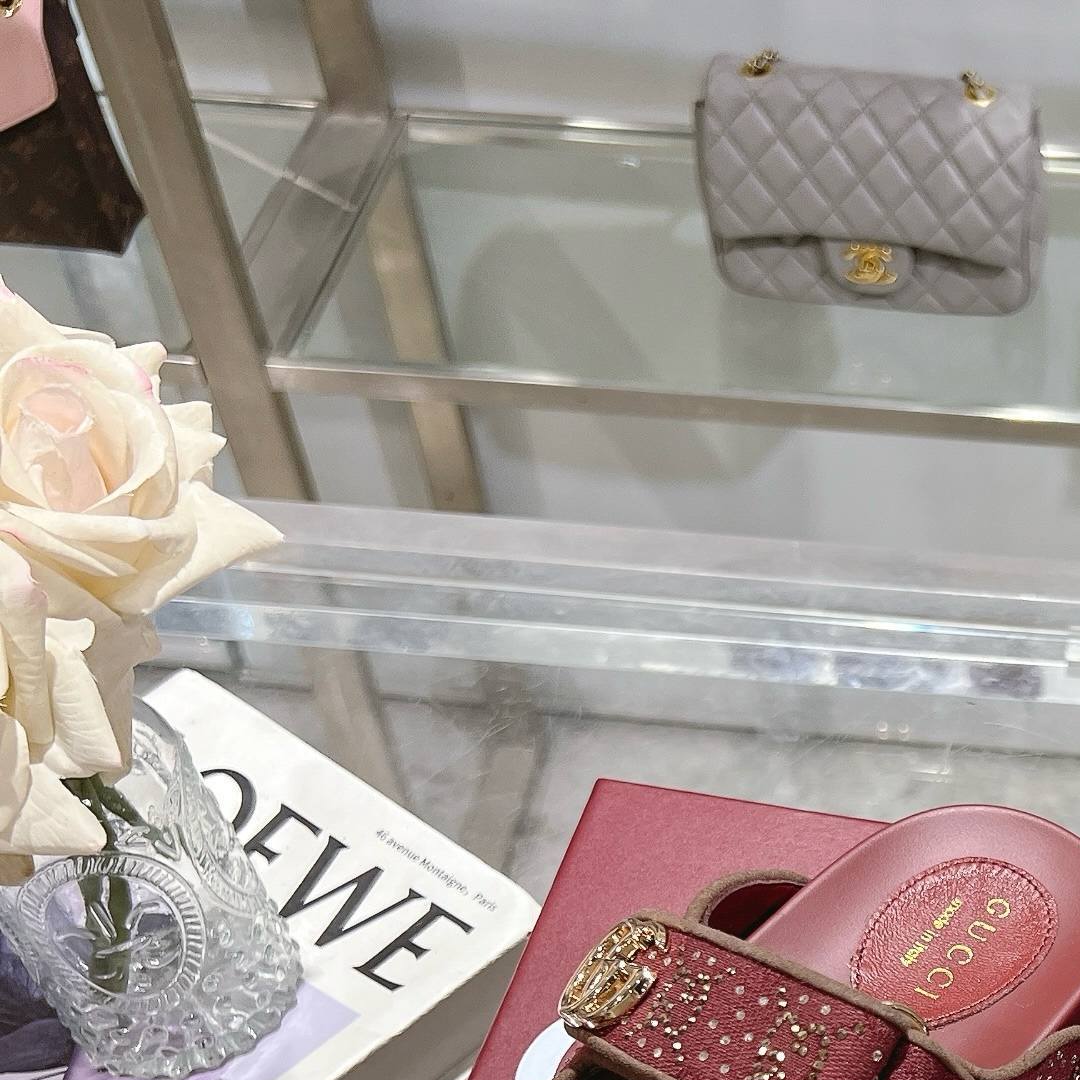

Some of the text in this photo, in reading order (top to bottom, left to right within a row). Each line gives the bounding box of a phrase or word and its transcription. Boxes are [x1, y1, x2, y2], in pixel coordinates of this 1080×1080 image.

[200, 768, 475, 992] OEWE
[385, 837, 421, 863] avenue
[473, 891, 498, 913] Paris
[899, 897, 962, 968] made in Italy
[913, 898, 1011, 1000] GUCCI
